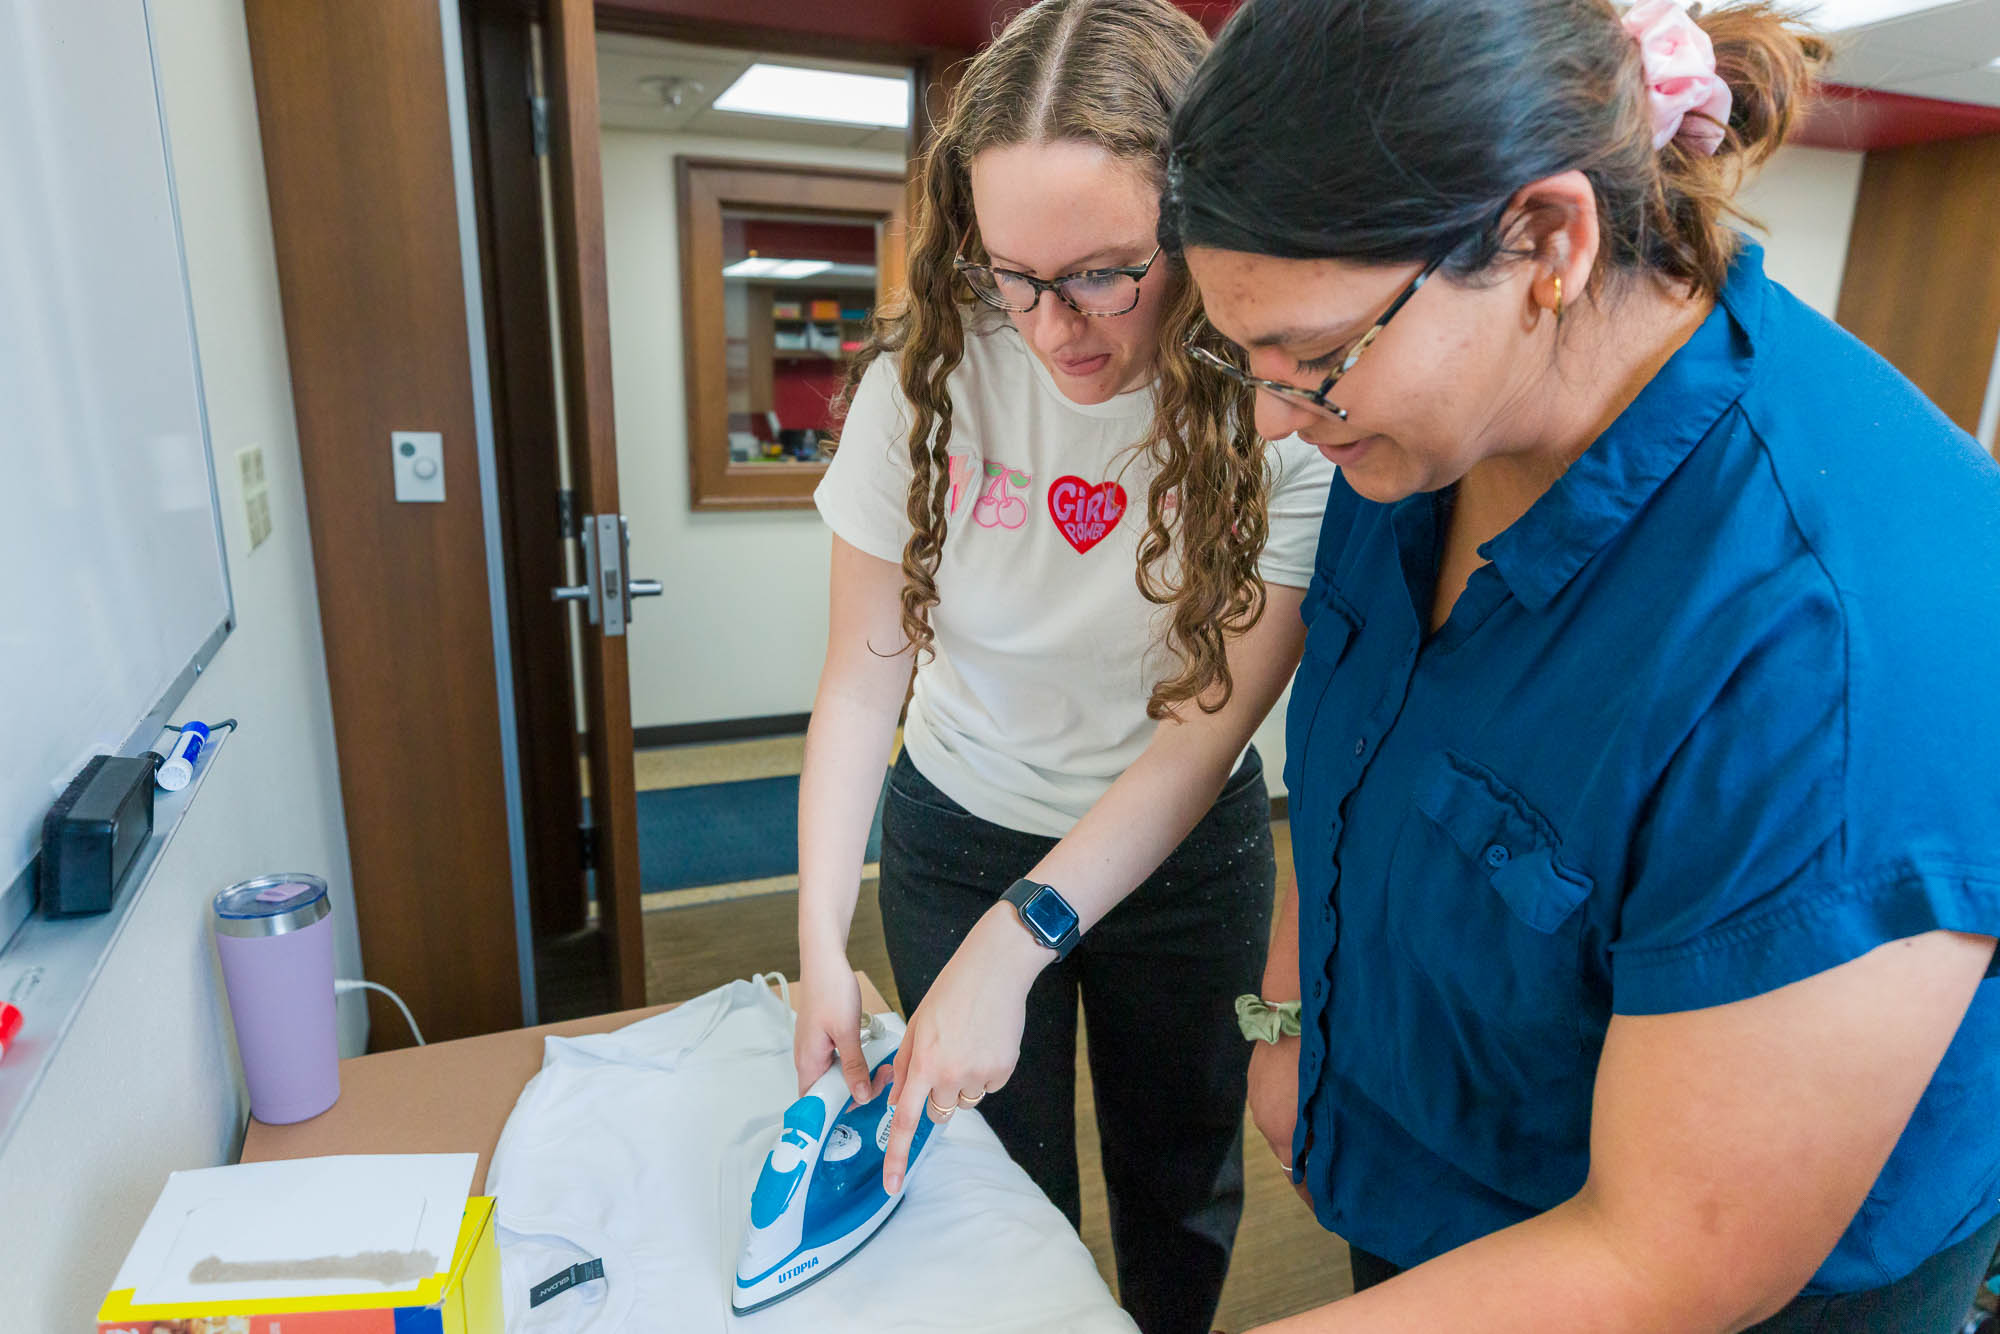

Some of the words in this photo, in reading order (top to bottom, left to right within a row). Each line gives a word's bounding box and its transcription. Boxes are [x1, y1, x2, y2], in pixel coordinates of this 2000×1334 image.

[1064, 522, 1107, 544] POWER
[778, 1256, 819, 1284] UTOPIA
[540, 1276, 570, 1297] GILDAN
